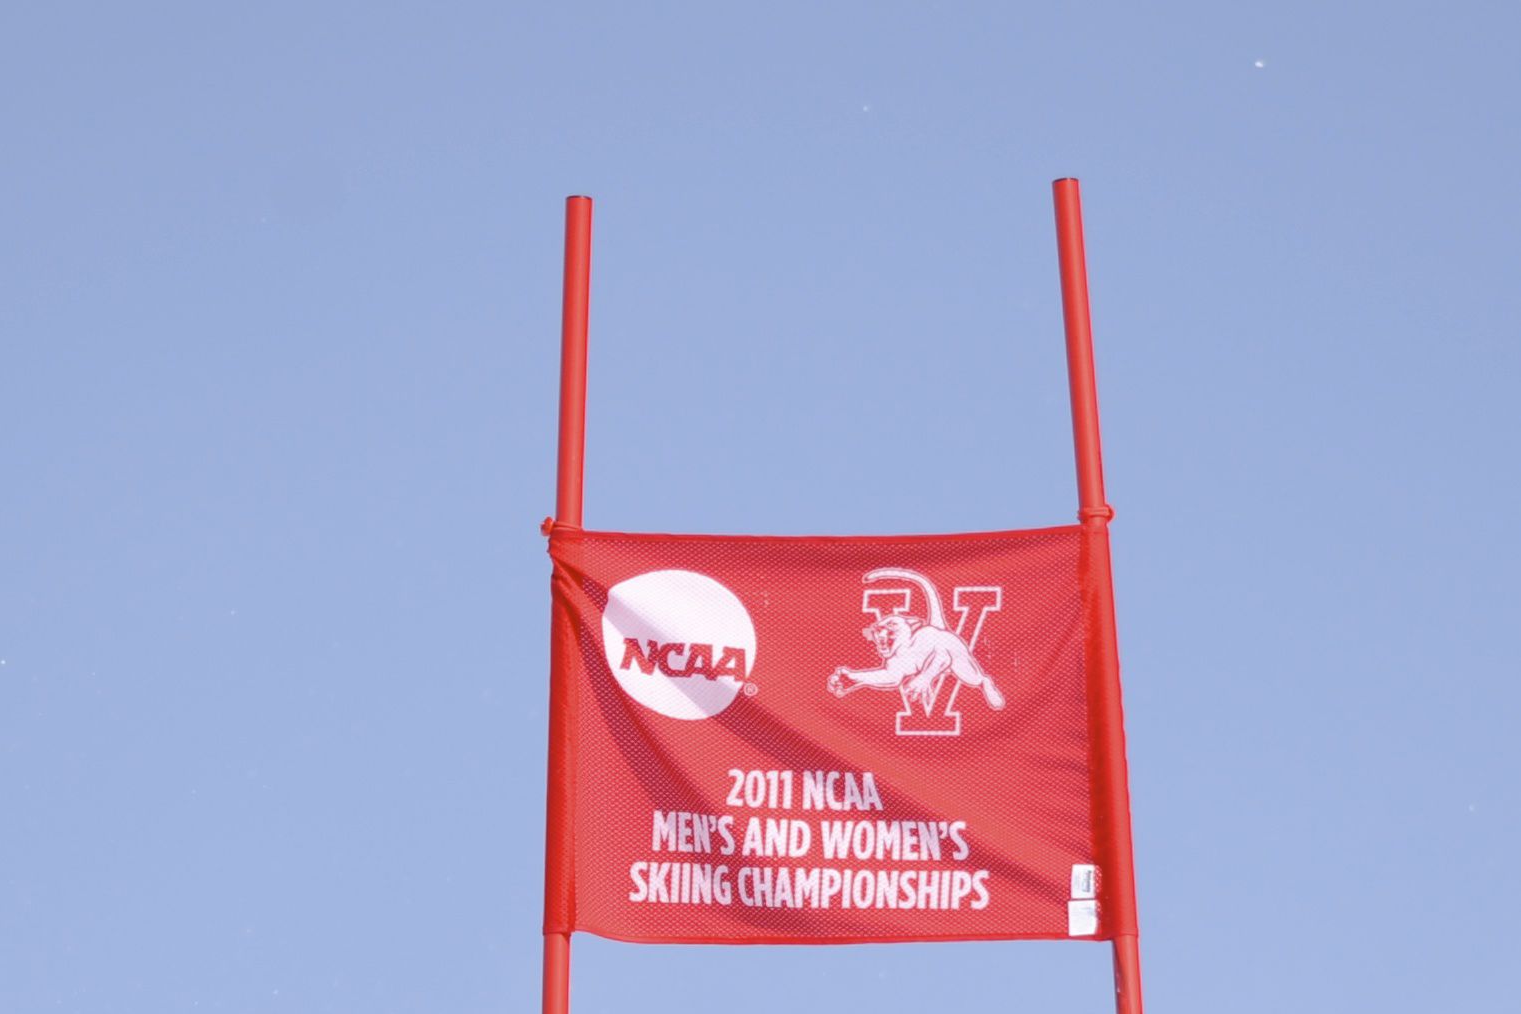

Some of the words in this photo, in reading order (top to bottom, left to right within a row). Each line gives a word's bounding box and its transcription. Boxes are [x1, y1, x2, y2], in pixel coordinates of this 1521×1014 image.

[620, 638, 747, 682] NCAA
[726, 768, 794, 809] 2011
[802, 770, 884, 811] NCAA
[652, 810, 735, 855] MEN’S
[742, 816, 812, 857] AND
[820, 820, 970, 861] WOMEN’S
[629, 861, 732, 906] SKIING
[738, 866, 991, 910] CHAMPIONSHIPS
